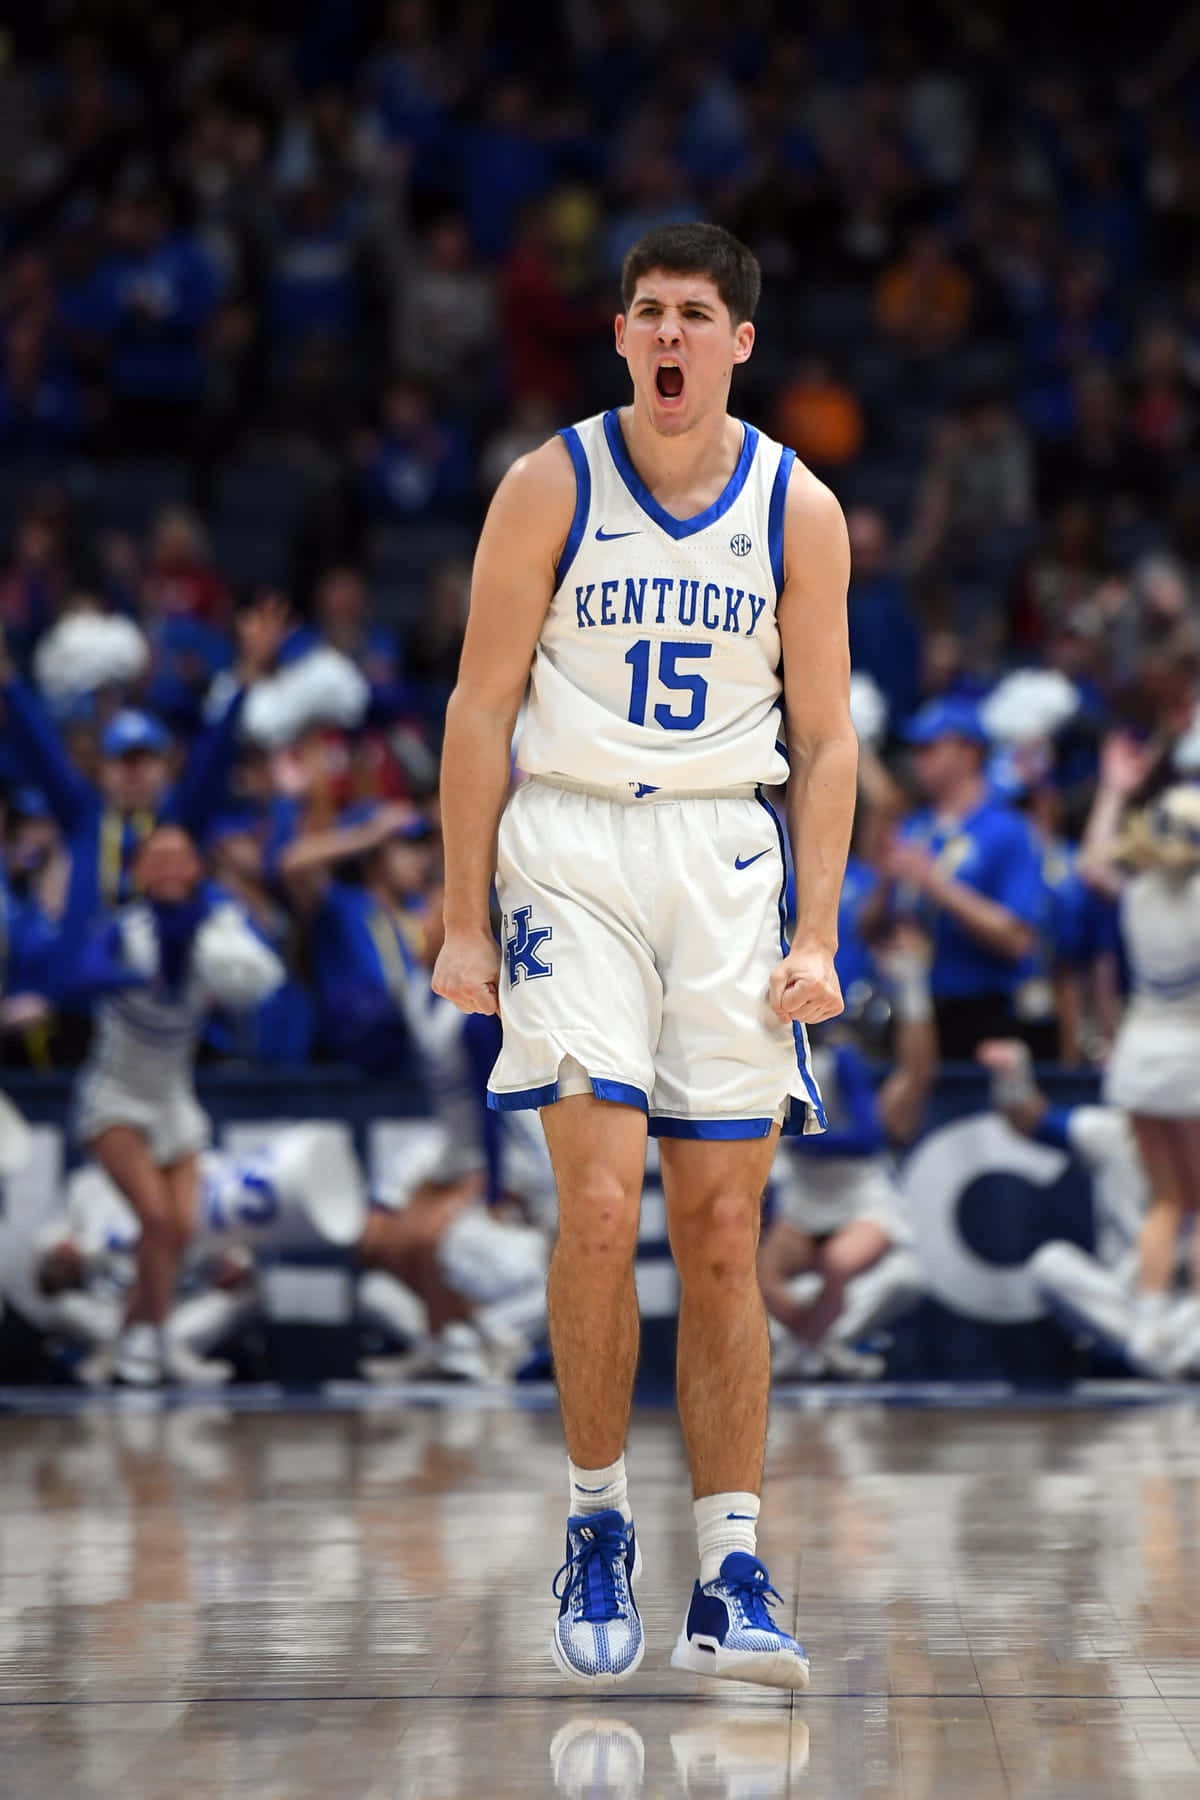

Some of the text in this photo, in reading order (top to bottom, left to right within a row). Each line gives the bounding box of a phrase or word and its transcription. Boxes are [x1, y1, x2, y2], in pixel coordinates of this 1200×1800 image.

[730, 534, 752, 557] SEC
[575, 577, 766, 636] KENTUCKY
[624, 639, 713, 731] 15
